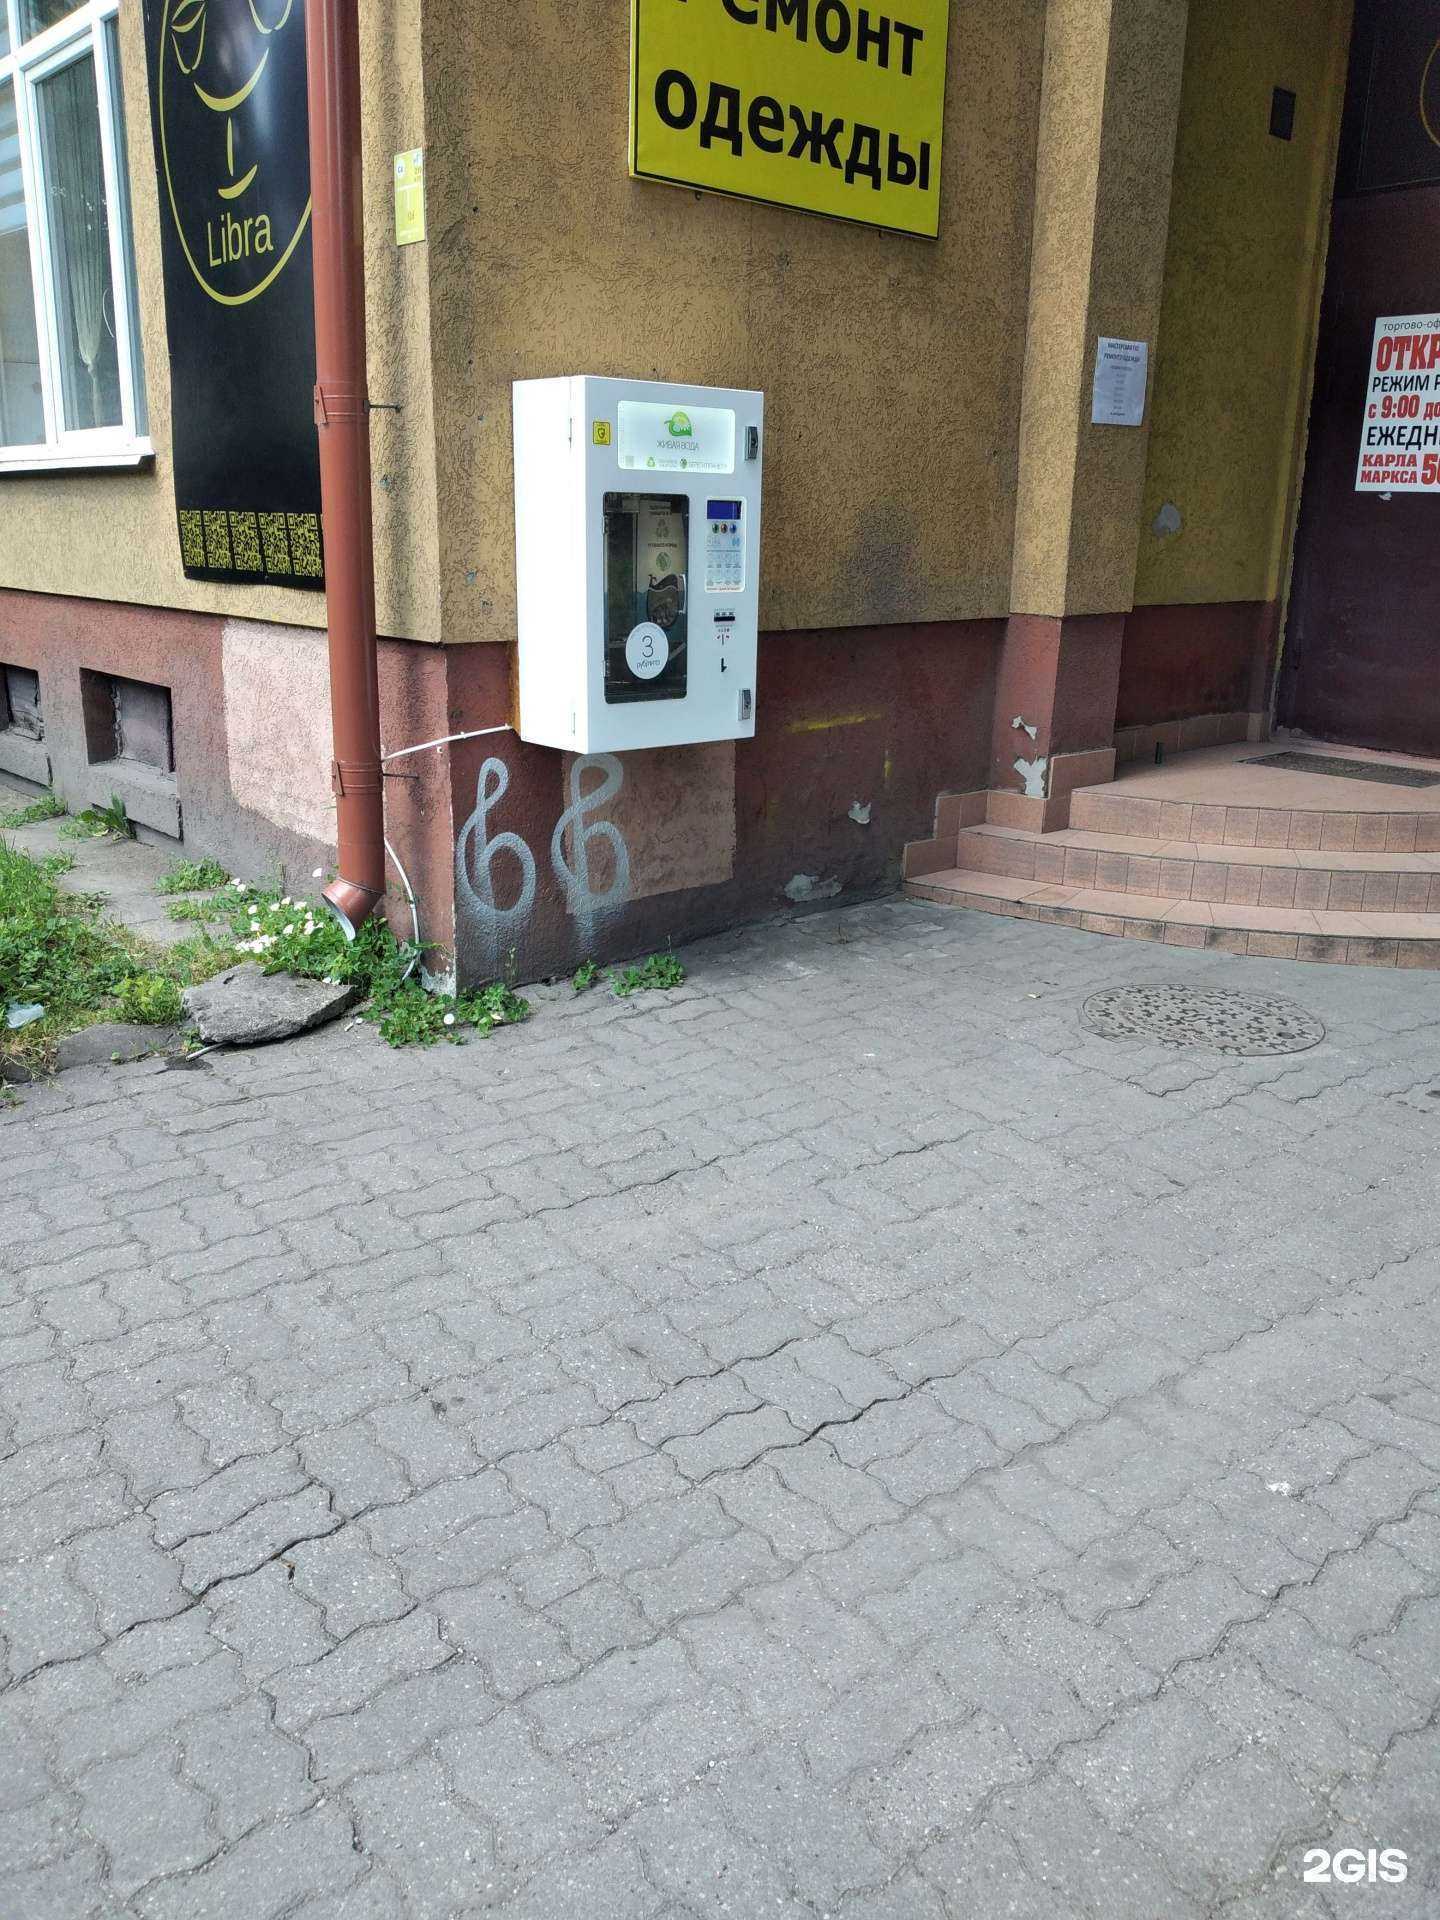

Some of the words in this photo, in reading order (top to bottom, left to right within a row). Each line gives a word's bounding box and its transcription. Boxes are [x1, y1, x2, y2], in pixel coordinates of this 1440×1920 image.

[655, 69, 931, 191] одежды
[207, 212, 274, 268] Libra
[1372, 374, 1430, 393] РЕЖИМ
[1381, 394, 1421, 419] 9:00
[1360, 470, 1418, 484] МАРКСА
[1362, 454, 1418, 467] КАРЛА
[1421, 453, 1440, 485] 5
[641, 634, 654, 658] 3
